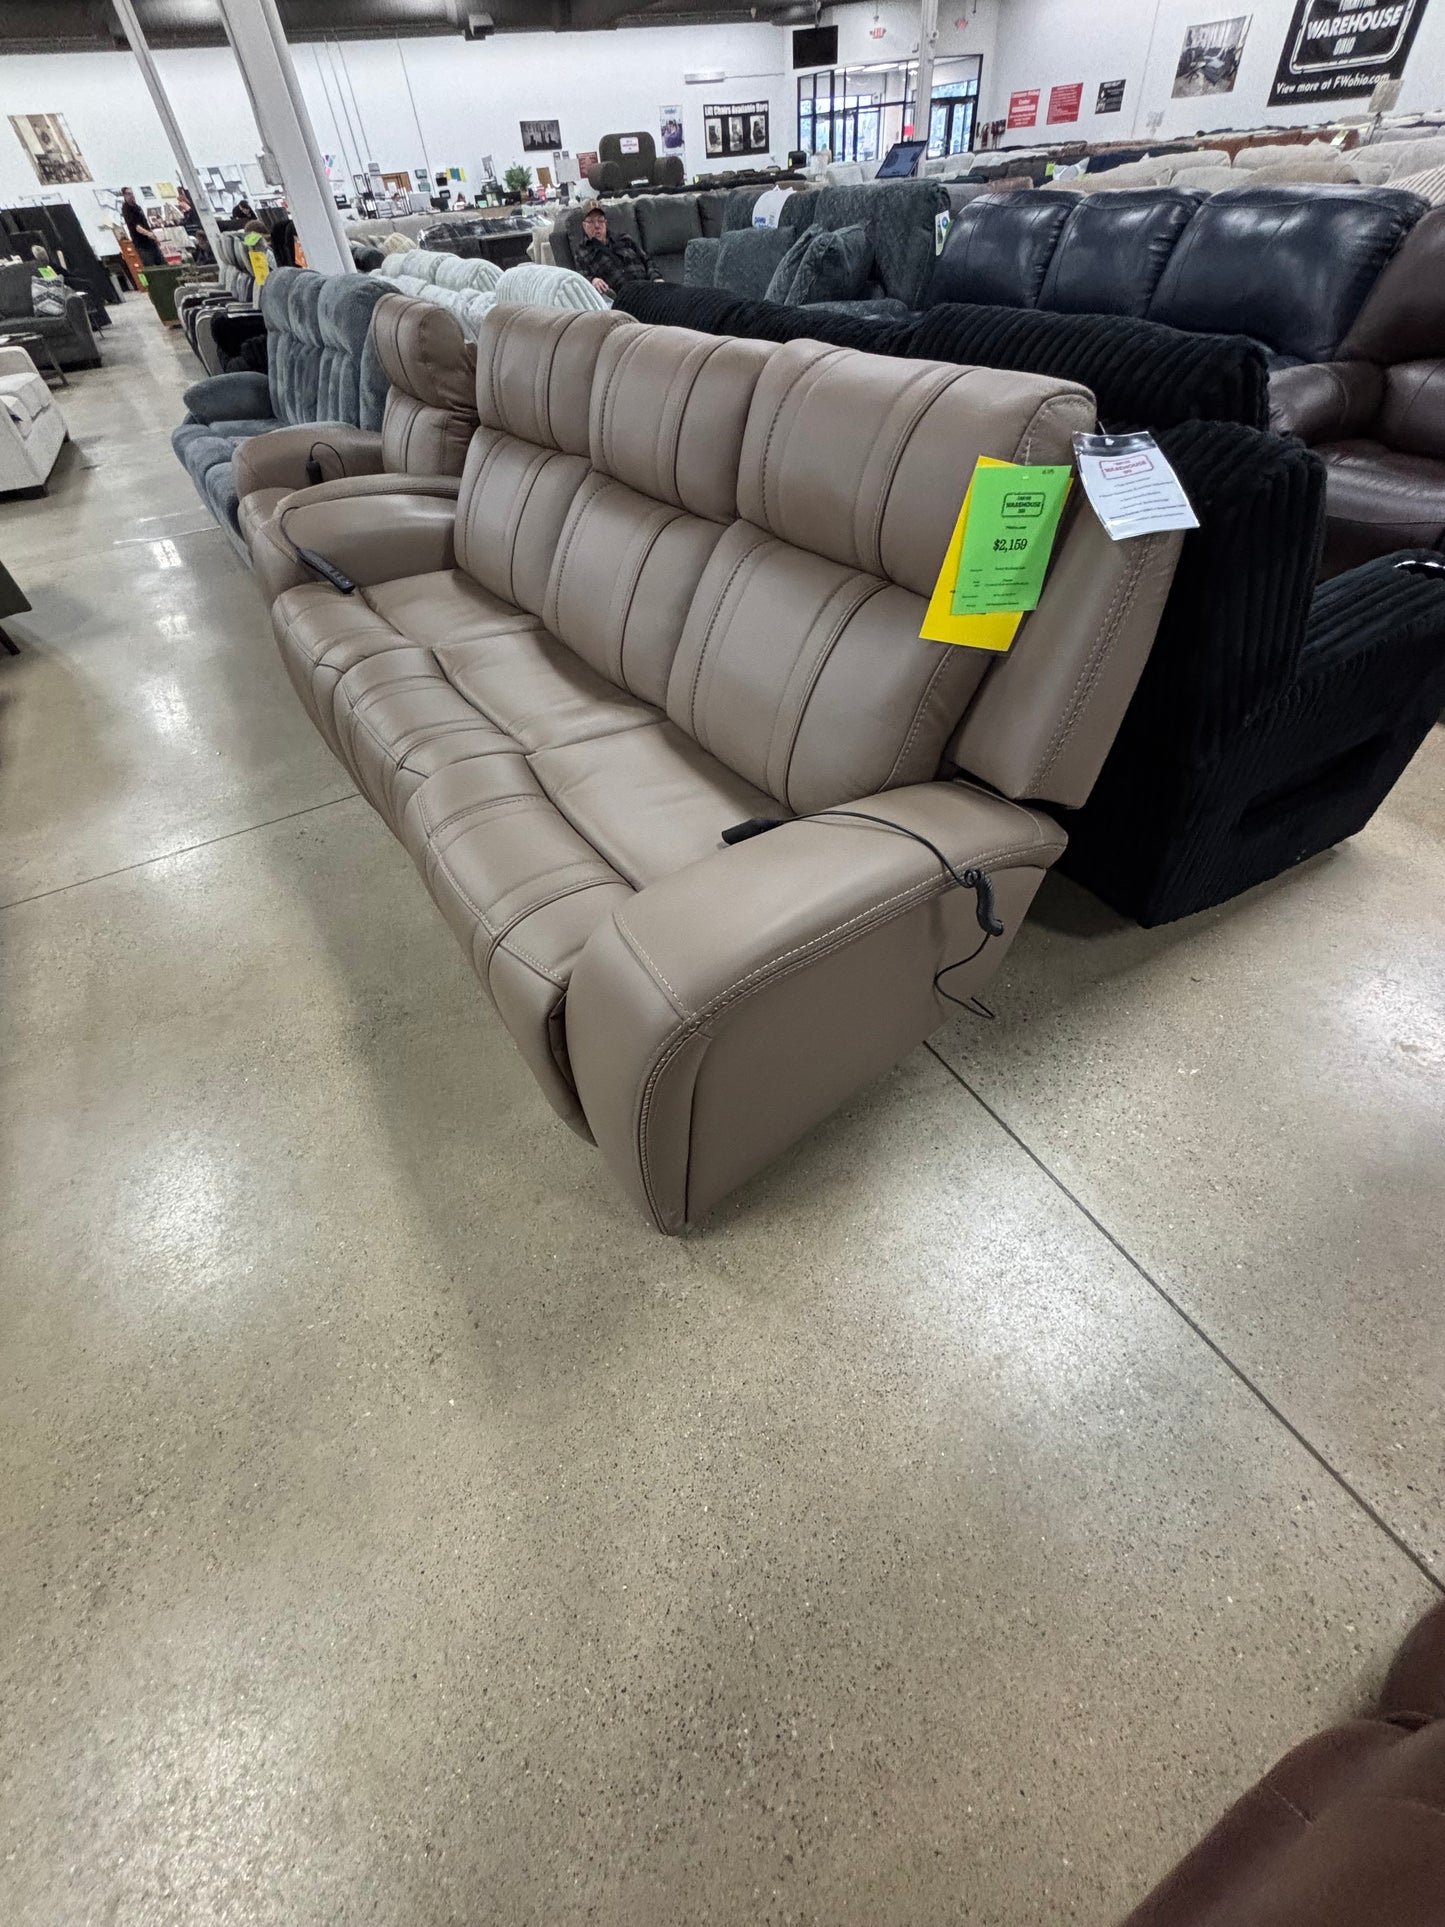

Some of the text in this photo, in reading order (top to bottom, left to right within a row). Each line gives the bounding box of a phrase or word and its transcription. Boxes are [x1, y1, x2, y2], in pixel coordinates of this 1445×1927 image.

[1307, 5, 1404, 40] WAREHOUSE
[1276, 73, 1391, 94] View more at FWohio.com
[993, 538, 1028, 553] $2,159
